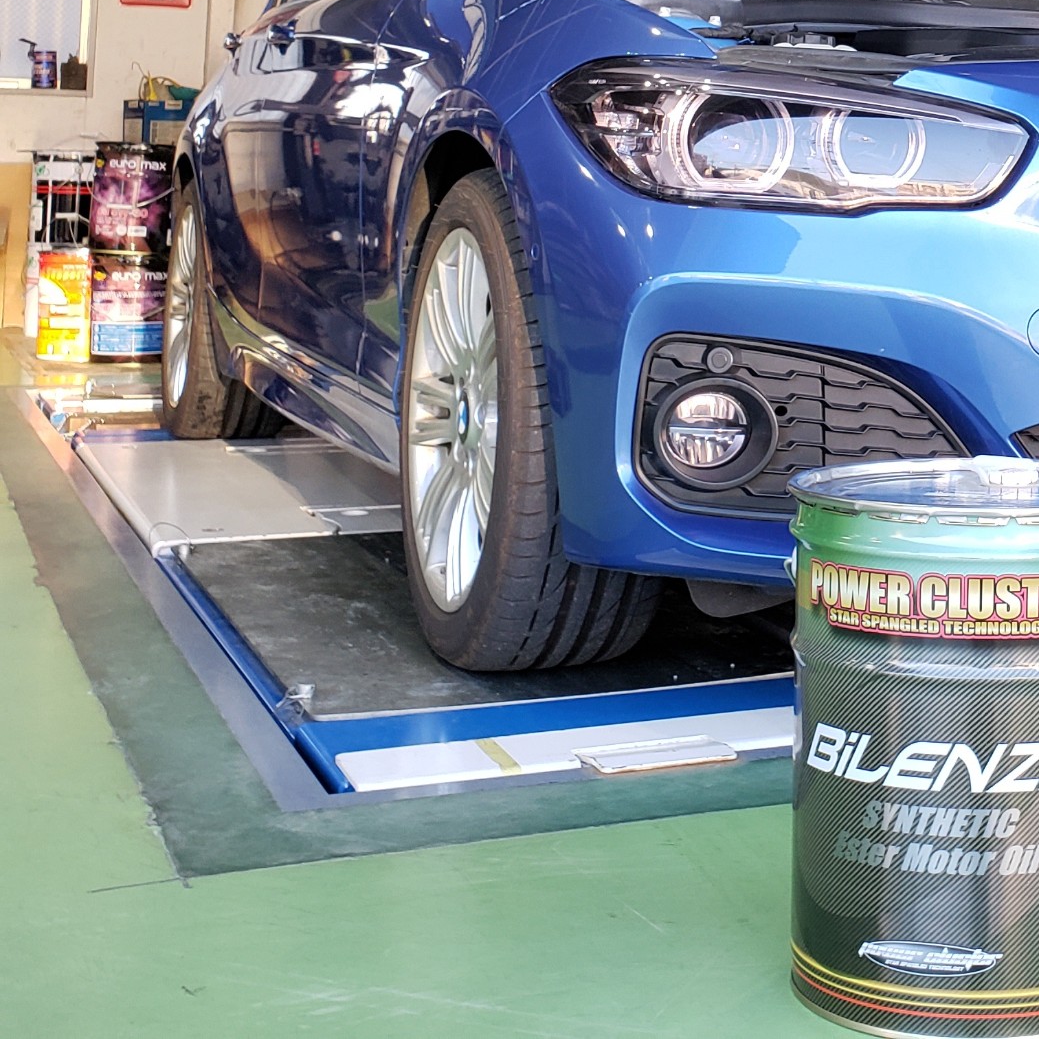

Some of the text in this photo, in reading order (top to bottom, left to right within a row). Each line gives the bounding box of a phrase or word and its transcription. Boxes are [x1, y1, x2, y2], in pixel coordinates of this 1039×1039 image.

[140, 159, 167, 171] max
[811, 561, 910, 617] POWER
[829, 609, 860, 626] STAR
[861, 613, 940, 635] SPANGLED
[862, 800, 1021, 839] SYNTHETIC
[901, 842, 997, 876] Motor
